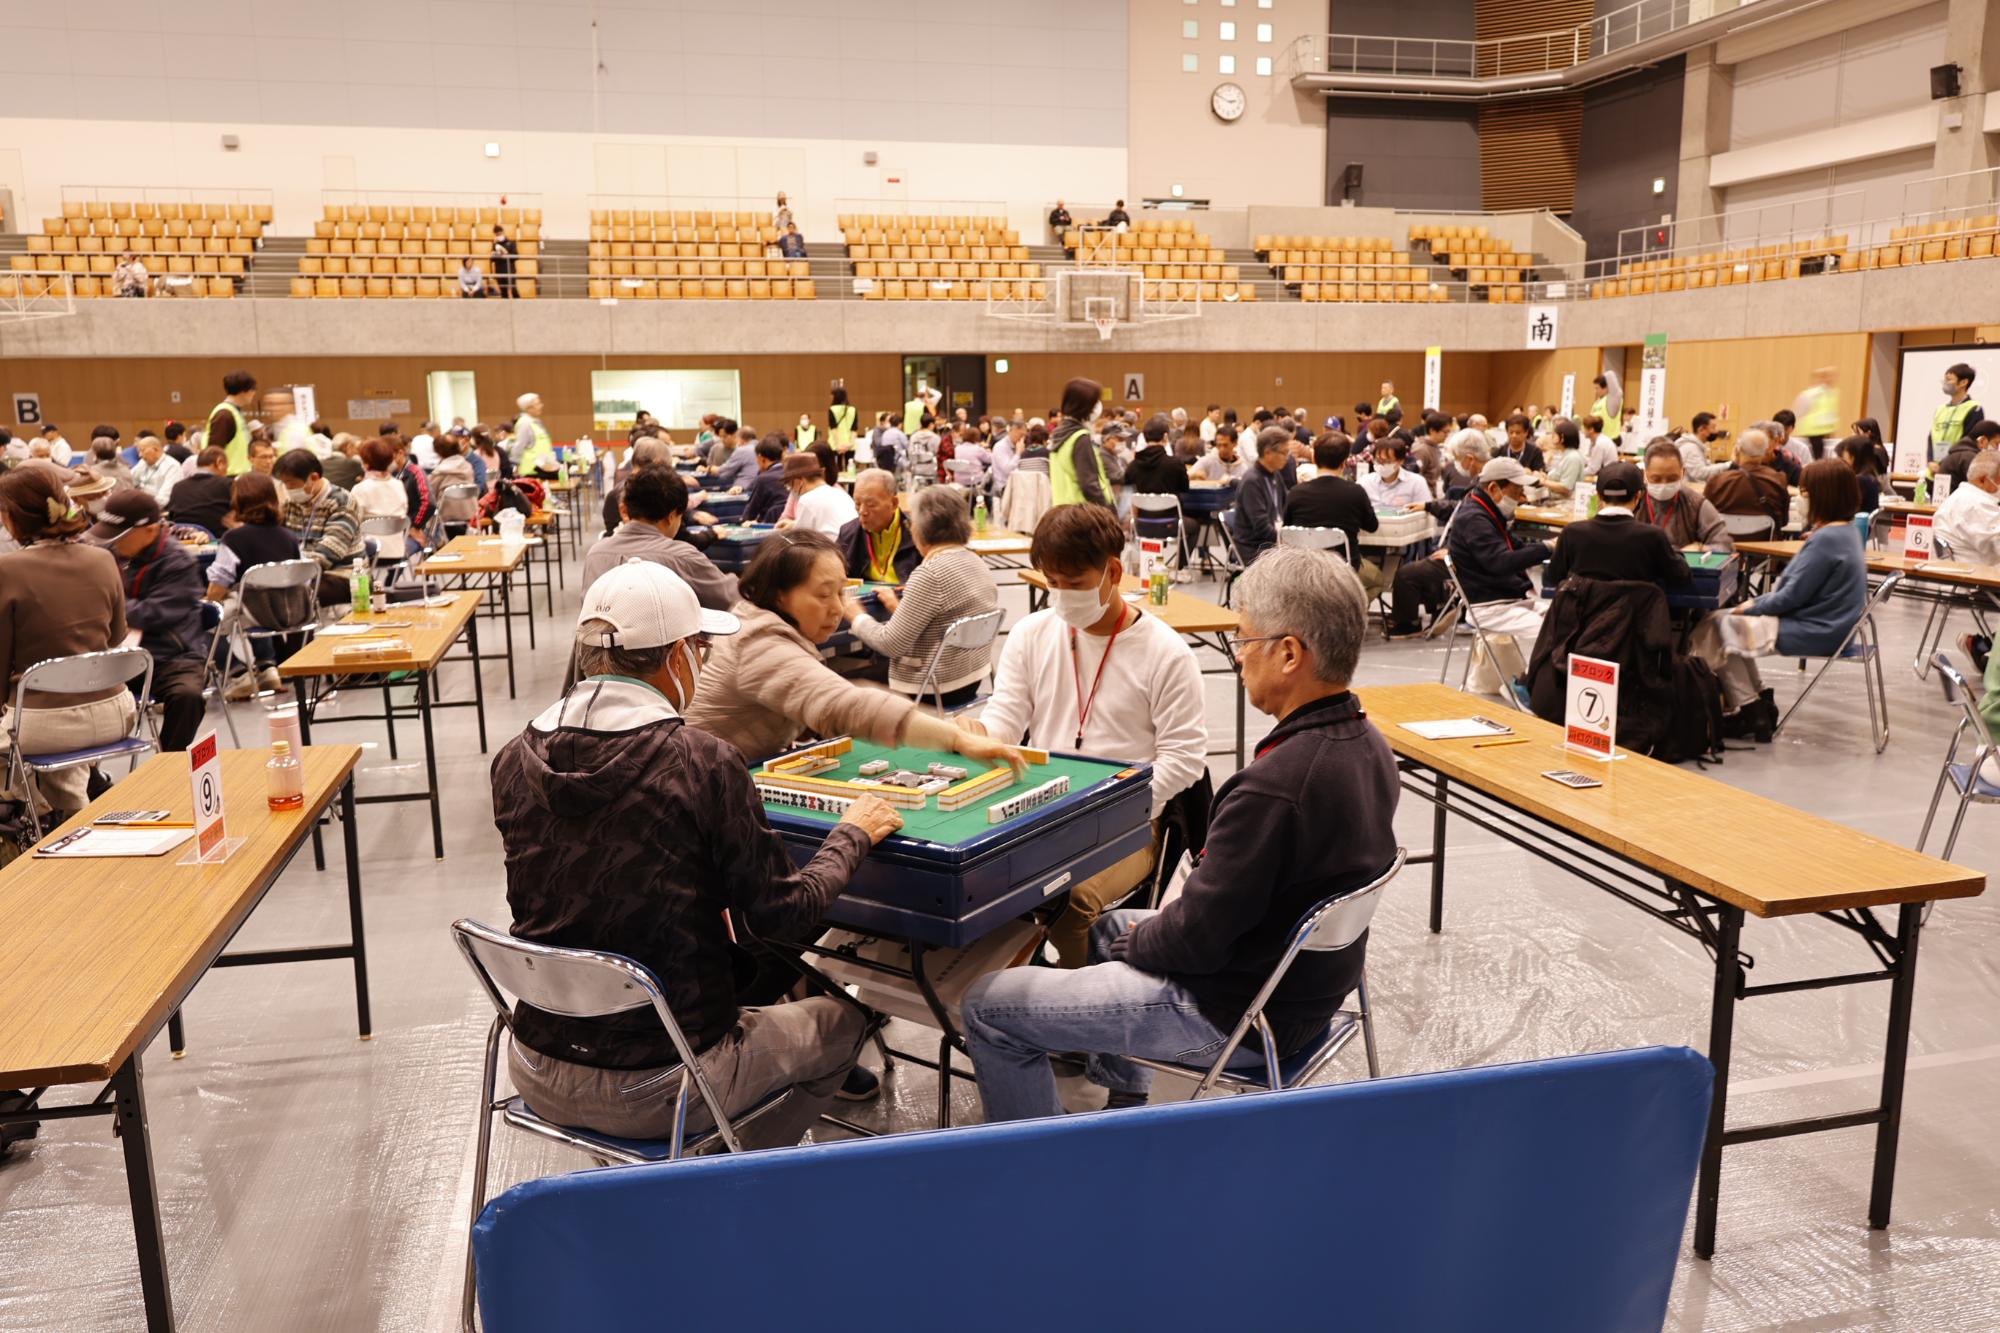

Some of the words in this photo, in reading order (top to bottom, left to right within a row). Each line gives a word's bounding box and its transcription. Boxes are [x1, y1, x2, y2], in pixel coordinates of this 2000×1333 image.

[1532, 313, 1553, 342] 南
[1126, 379, 1141, 399] A
[17, 400, 40, 424] B
